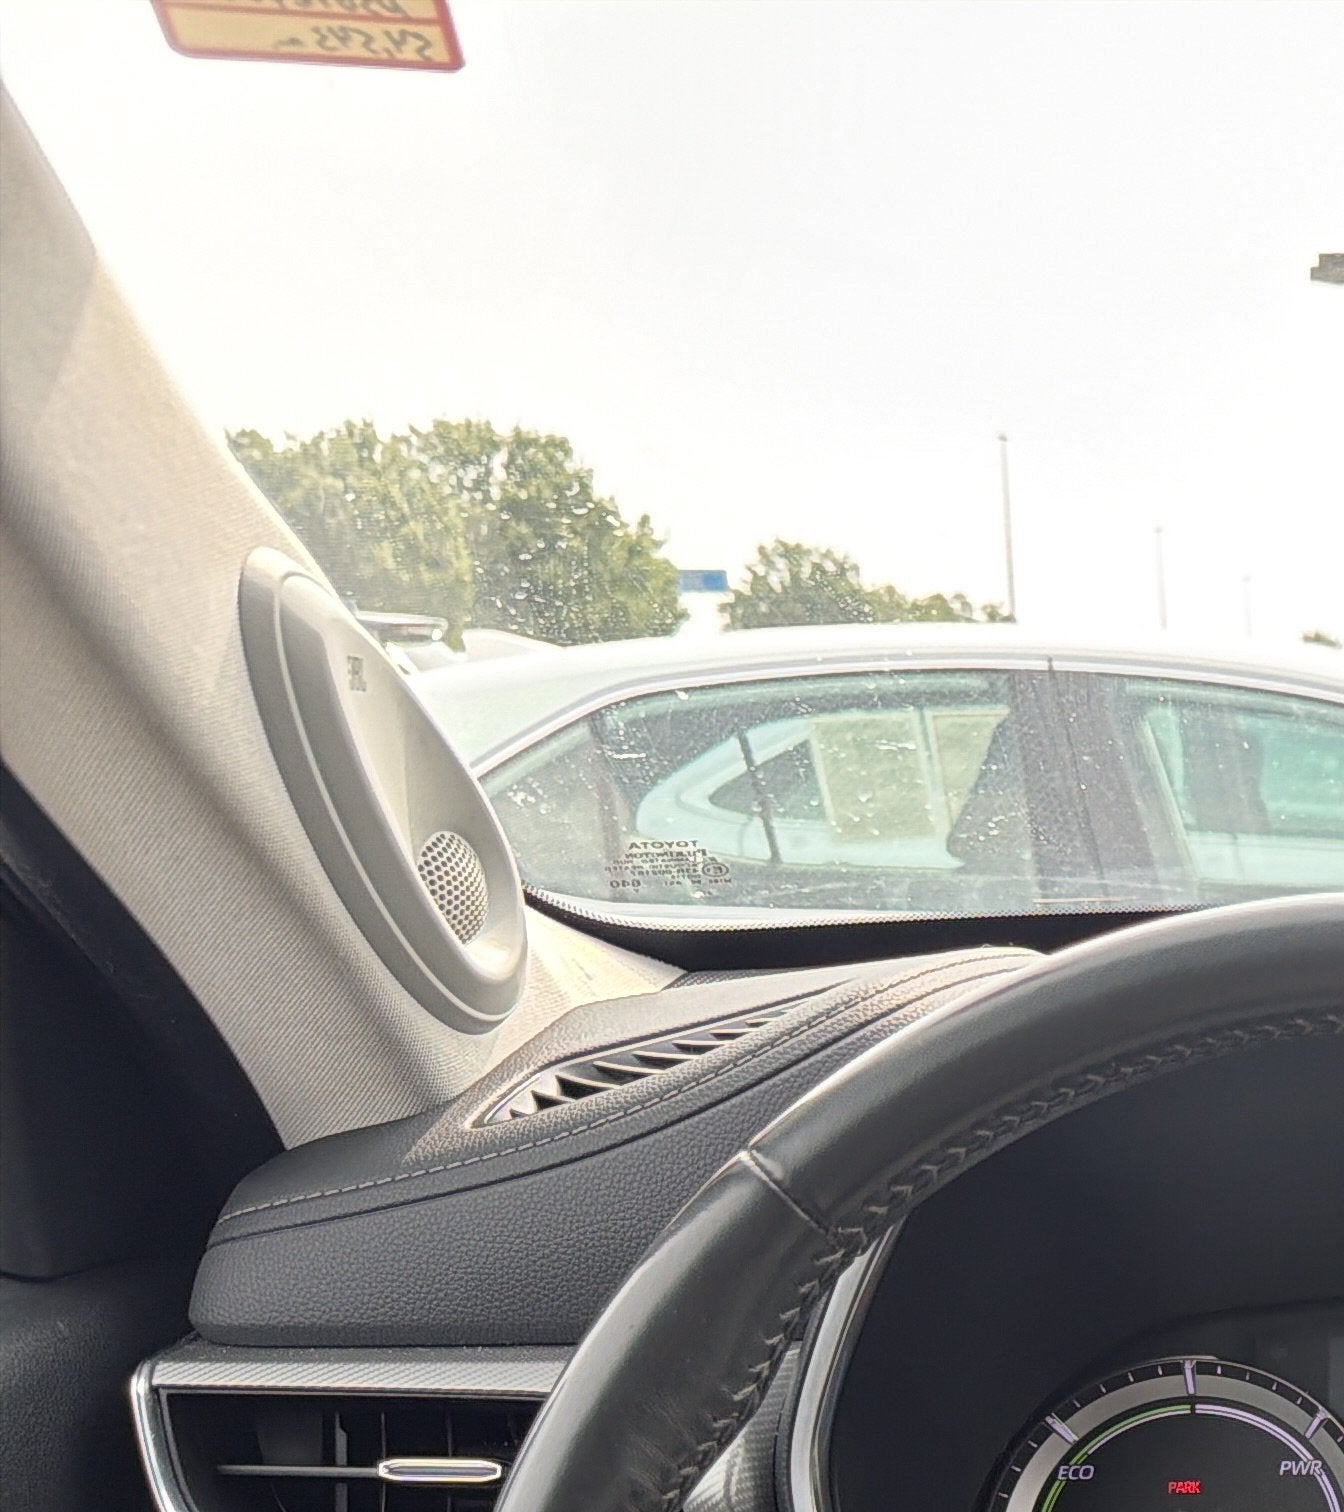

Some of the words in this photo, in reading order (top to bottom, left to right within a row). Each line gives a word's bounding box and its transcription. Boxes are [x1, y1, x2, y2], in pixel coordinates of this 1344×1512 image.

[1057, 1465, 1095, 1481] ECO
[1279, 1460, 1322, 1477] PWR
[1168, 1481, 1202, 1495] PARK
